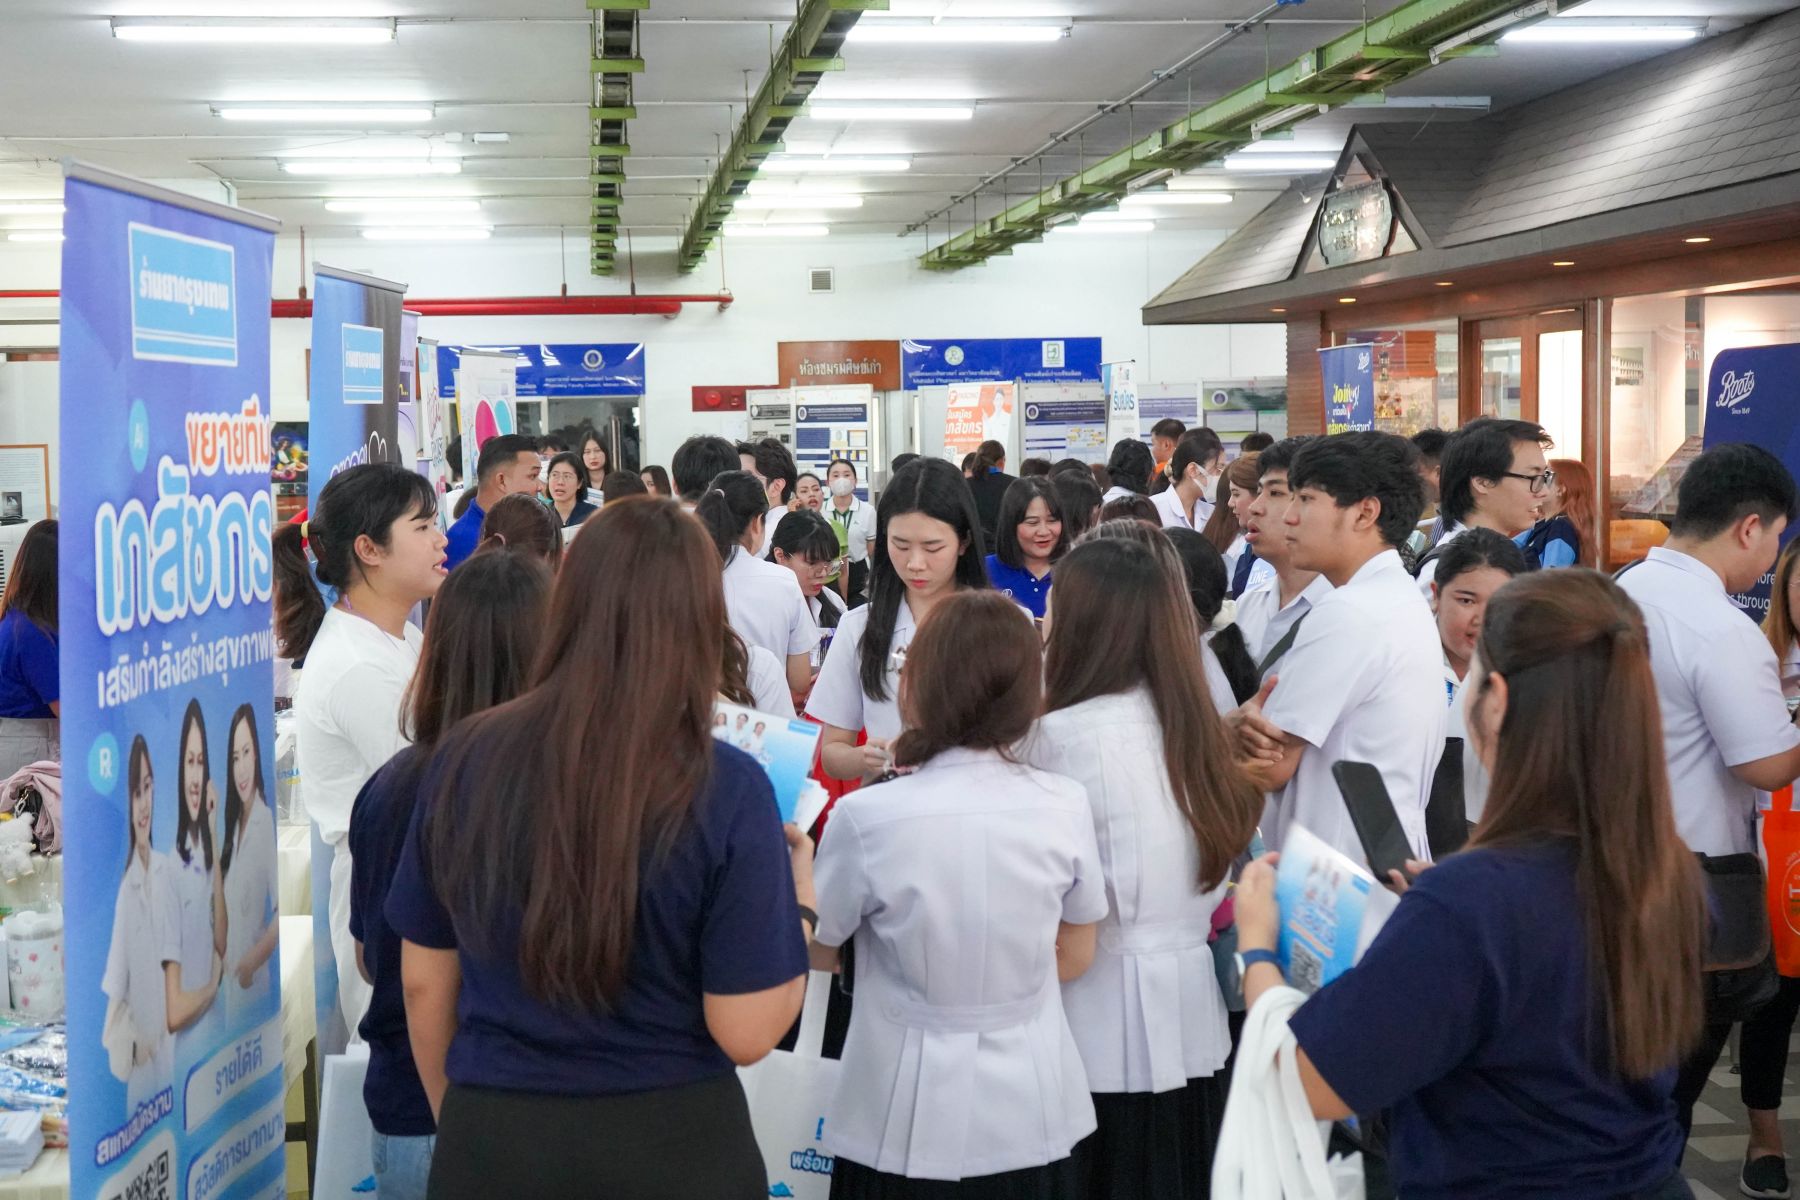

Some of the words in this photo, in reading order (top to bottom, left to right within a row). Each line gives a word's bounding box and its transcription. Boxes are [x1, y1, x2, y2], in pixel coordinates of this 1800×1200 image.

[1715, 369, 1755, 408] Boots
[96, 455, 272, 637] เภสัชกร
[1737, 592, 1771, 615] throug
[791, 1148, 834, 1175] พร้อม
